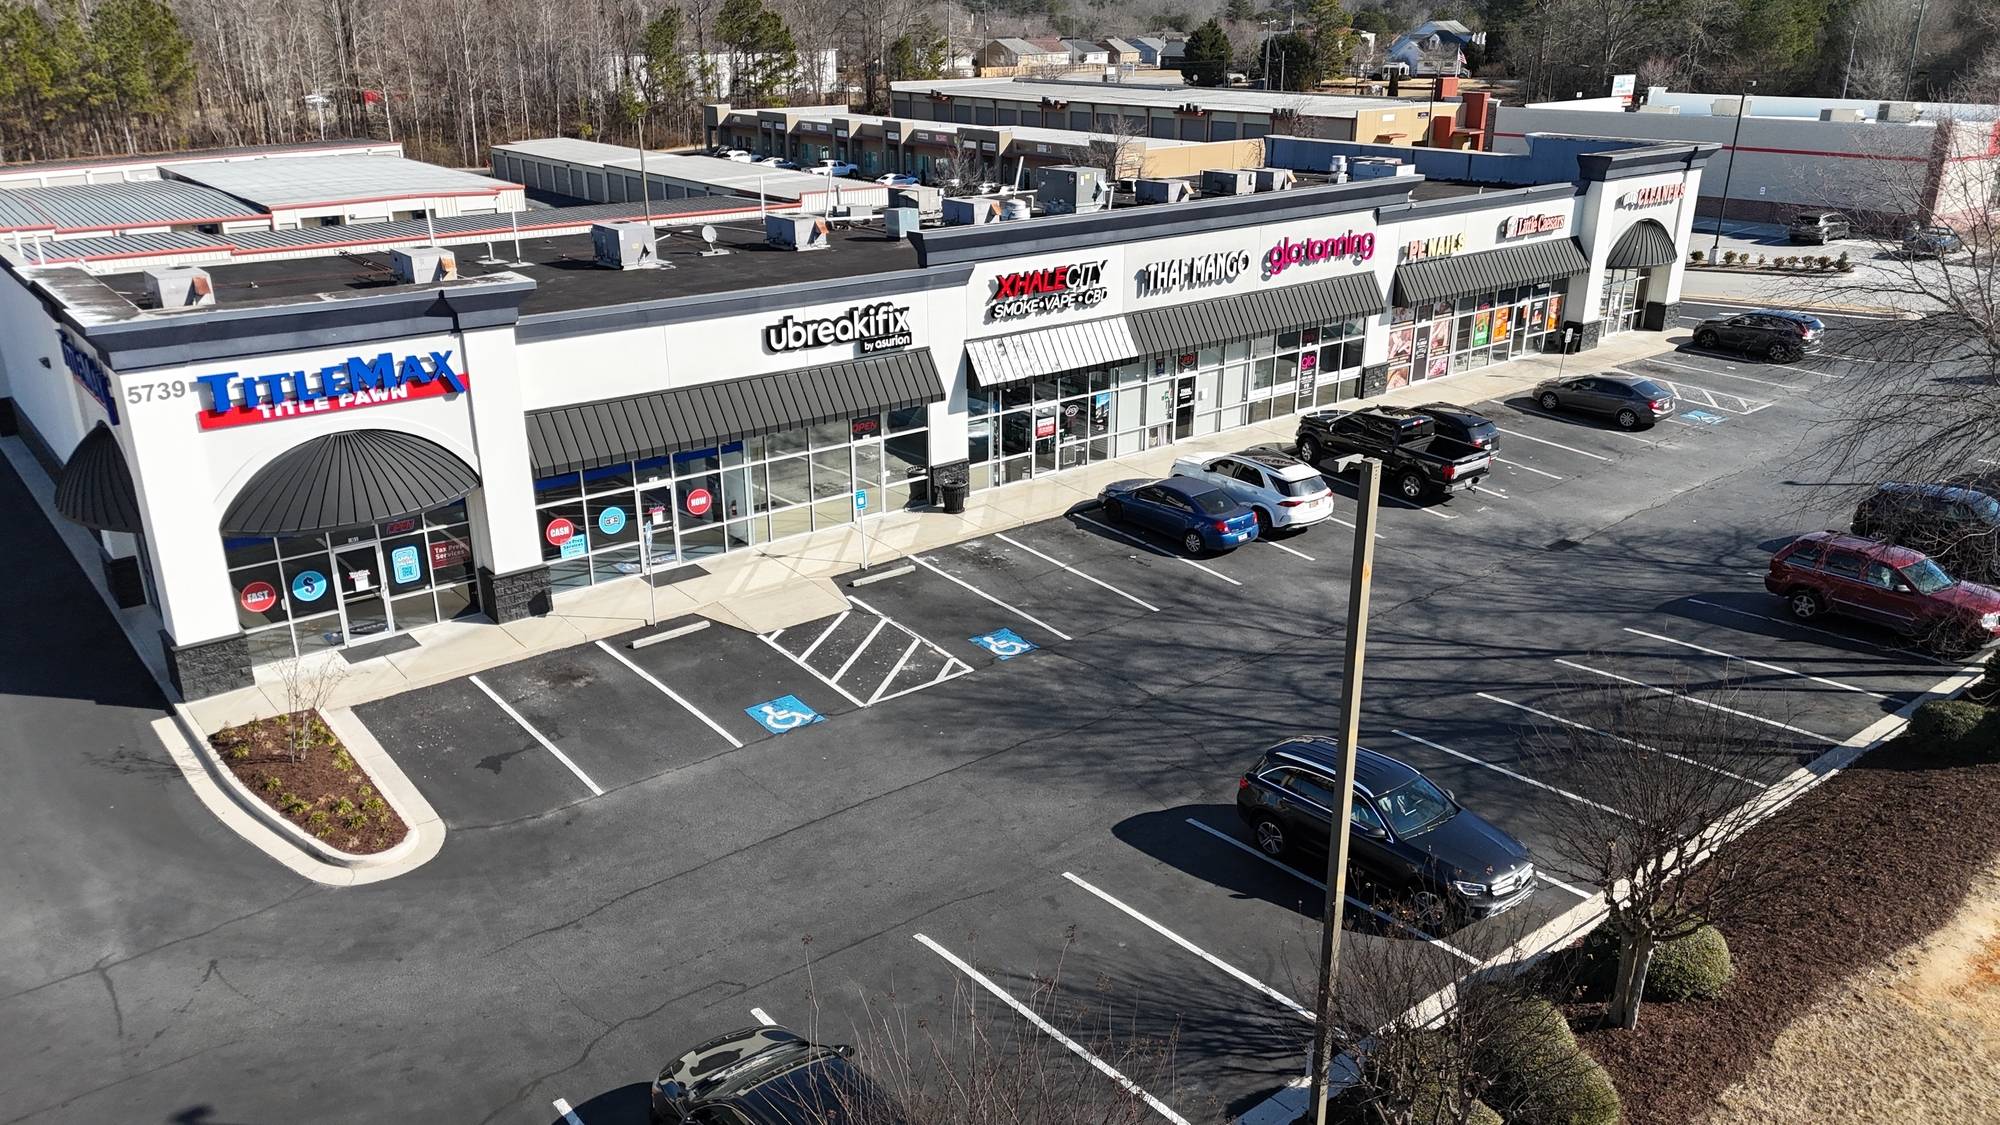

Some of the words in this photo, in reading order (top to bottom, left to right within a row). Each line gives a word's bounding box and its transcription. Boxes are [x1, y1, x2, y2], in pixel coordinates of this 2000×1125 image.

[1637, 182, 1686, 206] CLEANERS
[1517, 216, 1538, 236] Little
[1537, 214, 1565, 232] Caesars
[1269, 236, 1302, 275] glo
[1306, 229, 1375, 261] tanning
[1427, 232, 1465, 257] NAILS
[1191, 249, 1251, 284] MANGO
[766, 302, 911, 351] ubreakifix
[864, 342, 874, 351] by
[874, 335, 911, 348] asurion
[1301, 355, 1316, 370] glo
[127, 380, 186, 405] 5739
[257, 397, 330, 419] TITLE
[339, 384, 408, 409] PAWN
[853, 420, 877, 433] OPEN
[690, 496, 707, 506] NOW
[550, 525, 570, 538] CASH
[435, 550, 465, 560] Services
[247, 590, 269, 603] FAST
